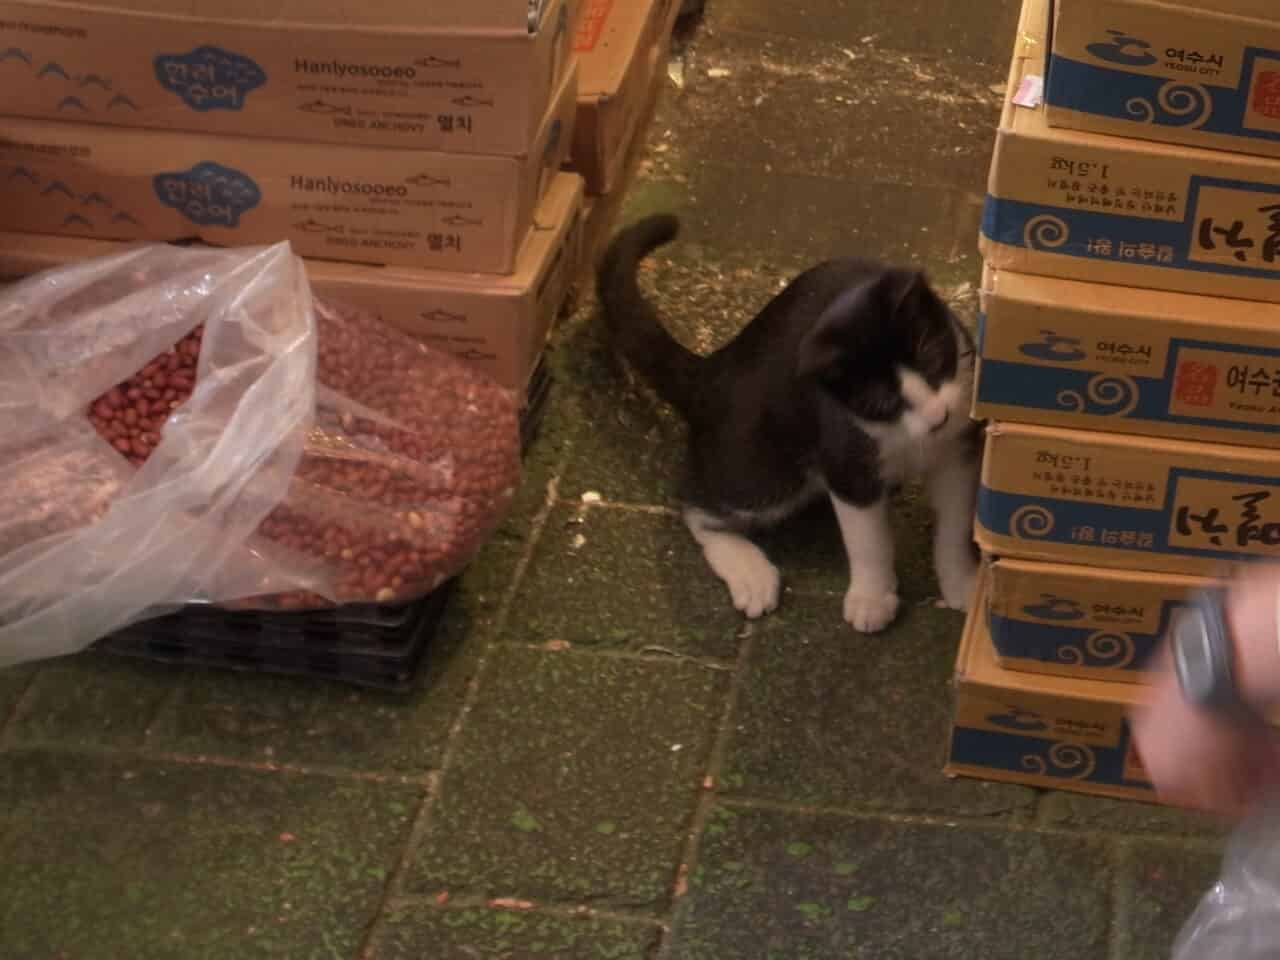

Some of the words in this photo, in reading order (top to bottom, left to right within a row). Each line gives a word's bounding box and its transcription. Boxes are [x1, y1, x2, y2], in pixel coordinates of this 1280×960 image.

[1165, 47, 1224, 68] 여수시
[438, 114, 472, 133] 멸치
[1050, 156, 1110, 179] 1.5kg
[291, 175, 408, 196] Hanlyosooeo
[427, 232, 461, 253] 멸치
[1097, 342, 1152, 359] 여수시
[1035, 451, 1092, 471] 1.5kg
